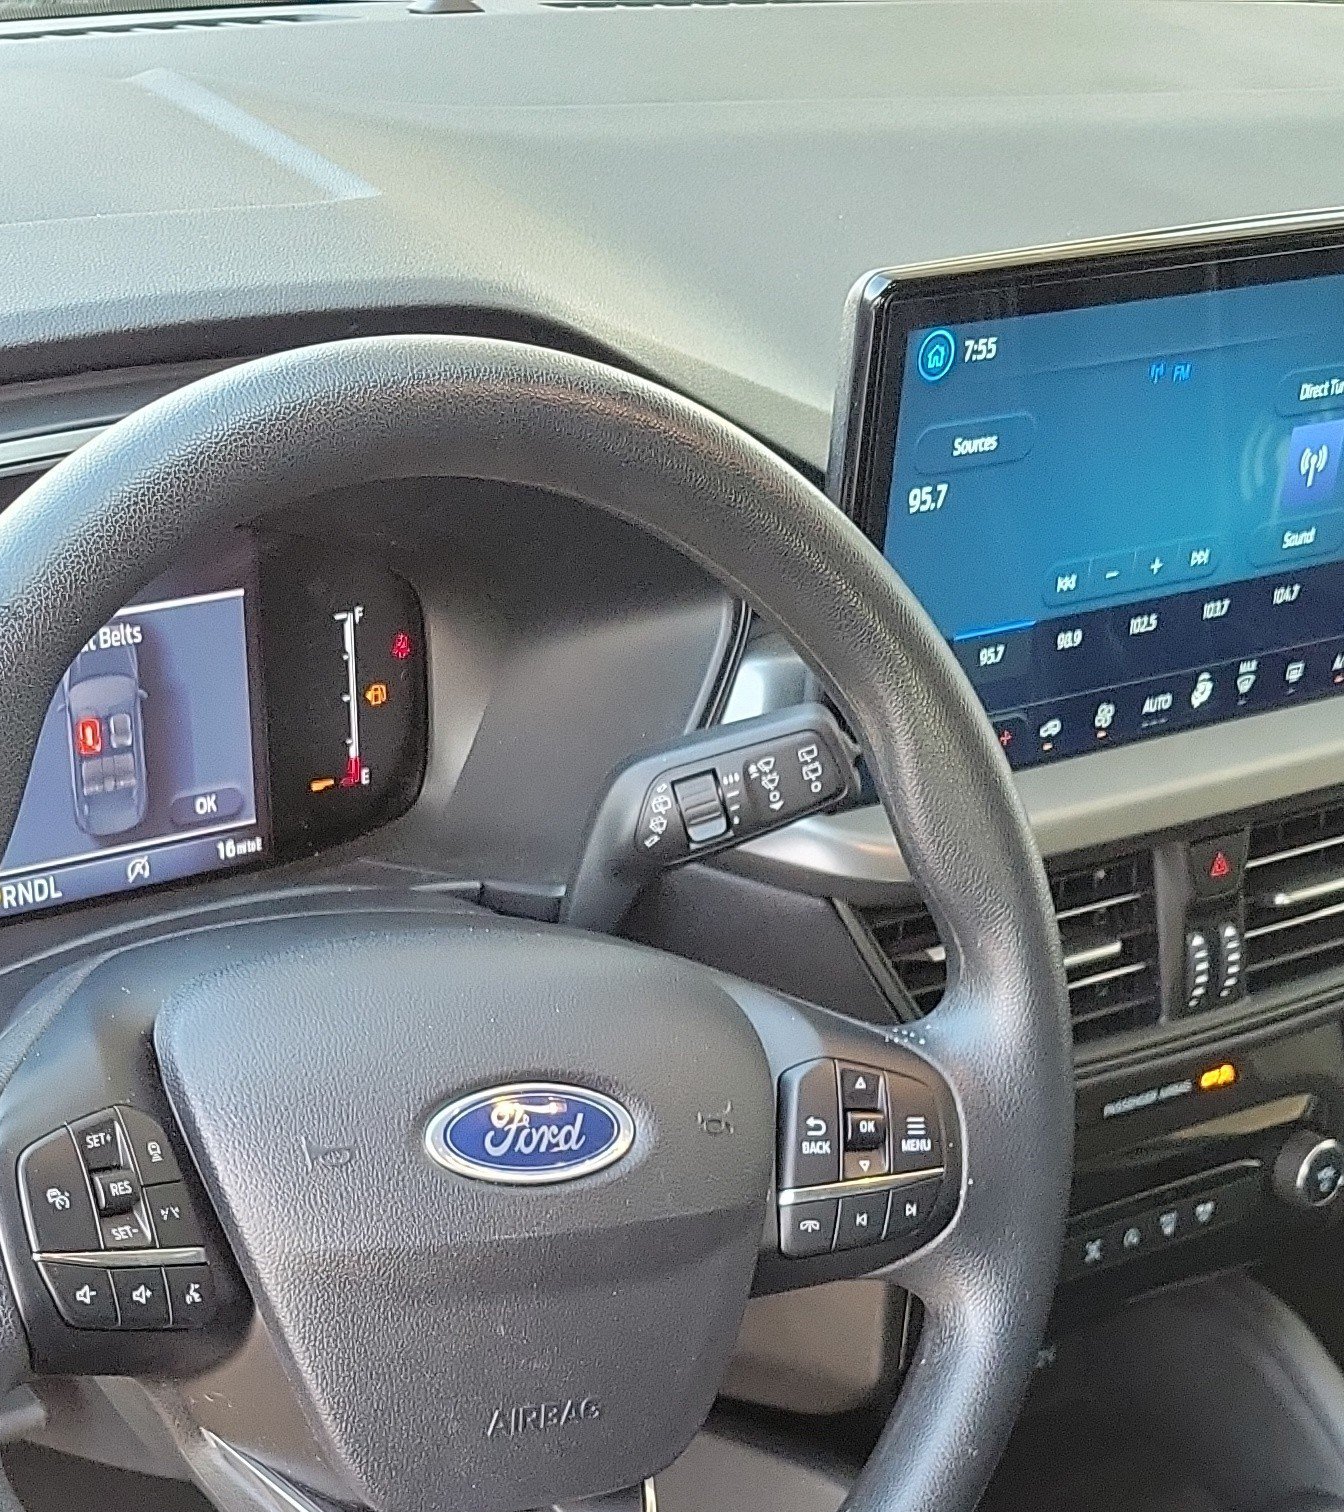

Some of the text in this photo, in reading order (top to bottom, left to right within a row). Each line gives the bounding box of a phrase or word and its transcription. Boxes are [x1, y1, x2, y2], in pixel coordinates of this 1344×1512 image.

[964, 337, 998, 362] 7:55
[1173, 364, 1192, 381] FM
[1299, 382, 1330, 401] Direct
[953, 435, 998, 456] Sources
[908, 484, 948, 514] 95.7
[1282, 526, 1316, 549] Sound
[99, 622, 143, 649] Belts
[979, 644, 1005, 667] 95.7
[1129, 613, 1158, 636] 102.5
[1142, 693, 1173, 715] AUTO
[361, 767, 370, 785] E
[195, 795, 217, 815] OK
[217, 838, 236, 860] 16
[484, 1100, 587, 1157] Ford
[859, 1120, 876, 1133] OK
[802, 1138, 932, 1154] BACK MENU
[109, 1181, 132, 1196] RES
[487, 1398, 601, 1436] AIRBAG
